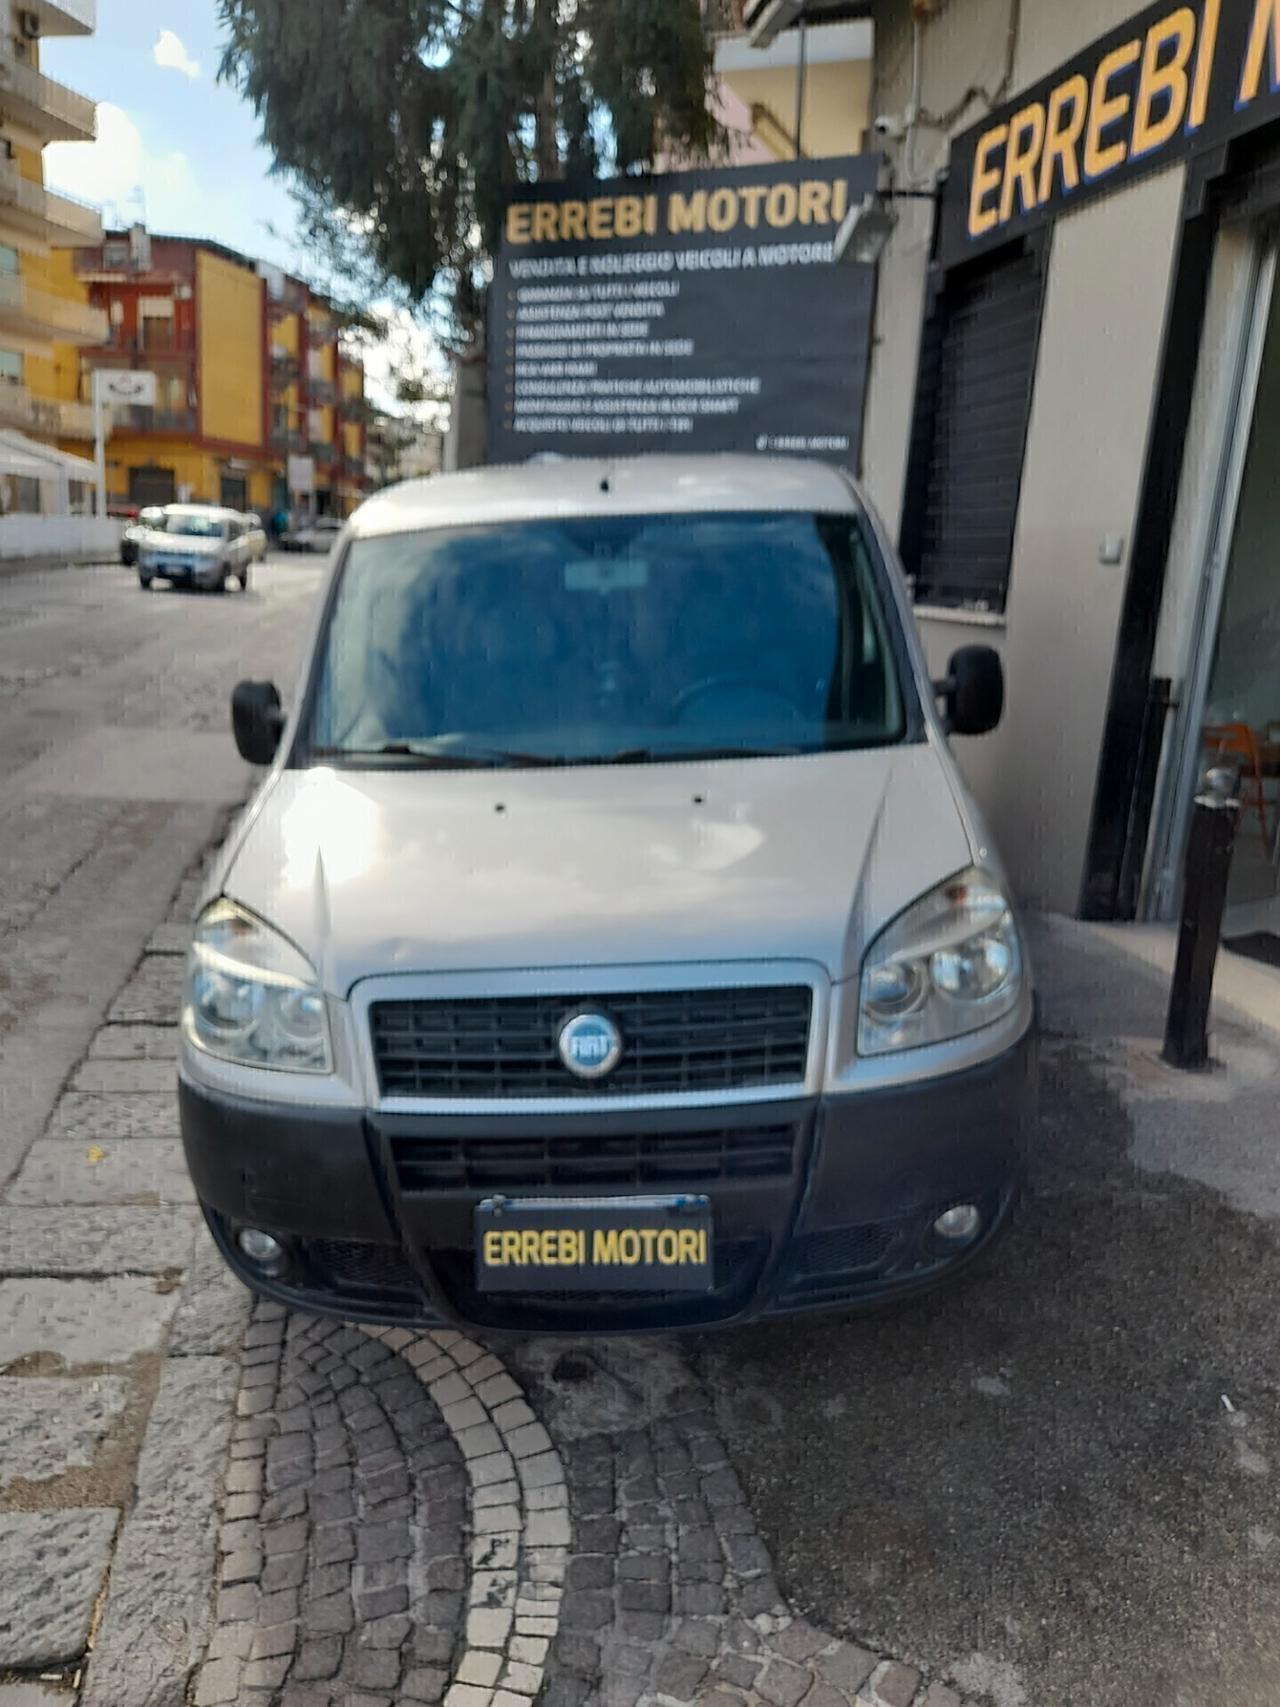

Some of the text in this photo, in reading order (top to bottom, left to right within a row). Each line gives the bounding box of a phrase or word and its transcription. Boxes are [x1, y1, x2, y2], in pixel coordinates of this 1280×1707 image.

[967, 0, 1222, 238] ERREBI
[505, 179, 848, 244] ERREBI MOTORI
[742, 246, 757, 268] A
[483, 1229, 706, 1265] ERREBI MOTORI
